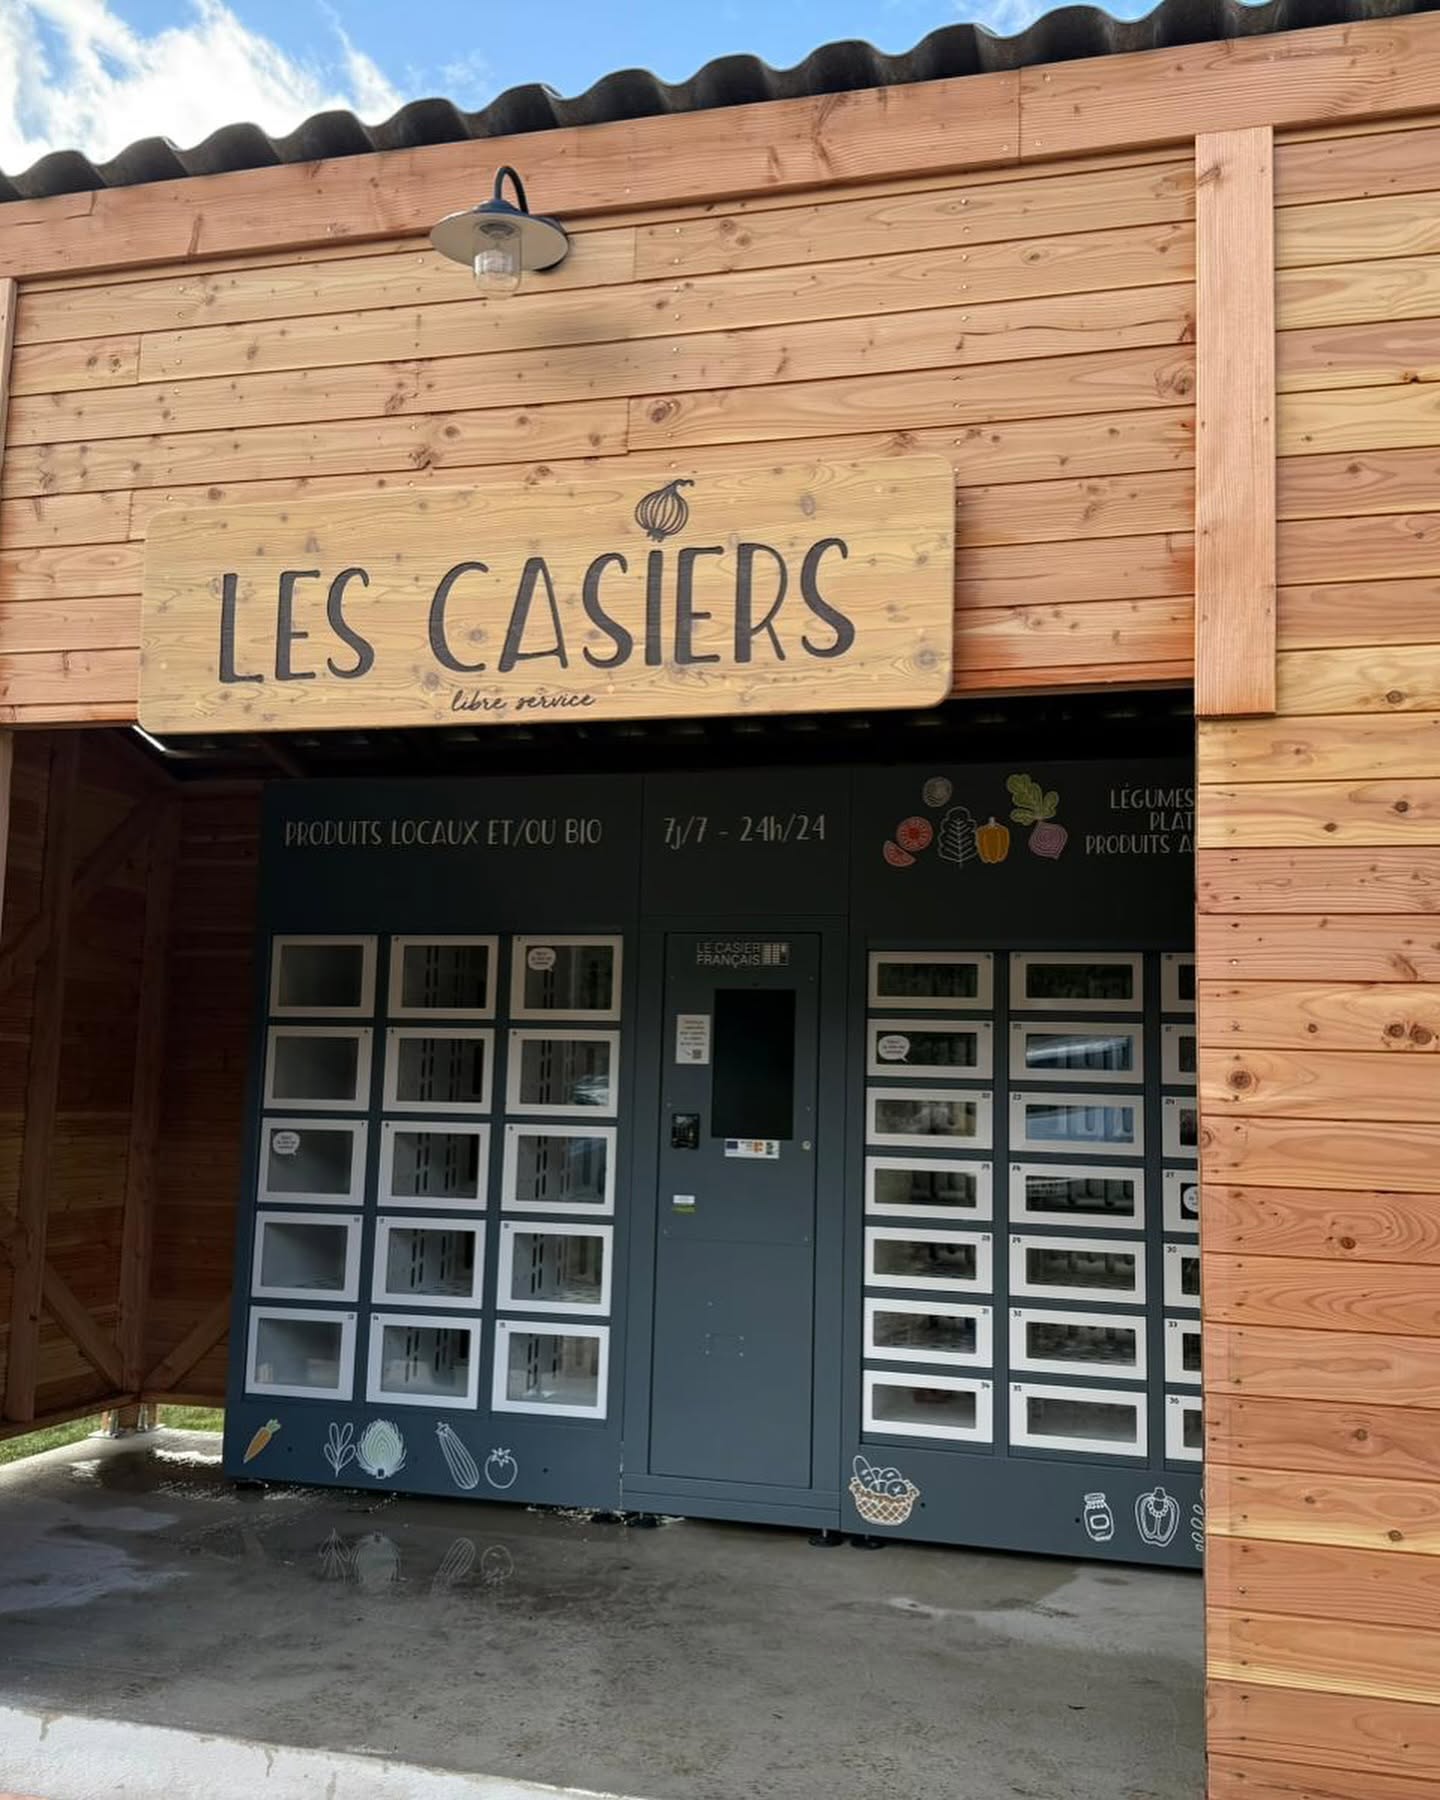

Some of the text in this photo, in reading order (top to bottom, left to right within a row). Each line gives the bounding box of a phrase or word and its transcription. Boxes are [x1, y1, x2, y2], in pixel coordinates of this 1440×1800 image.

[218, 537, 856, 685] LES CASIERS
[451, 689, 597, 713] libre service
[1110, 782, 1194, 809] LÉGUMES
[285, 817, 603, 847] PRODUITS LOCAUX ET/OU BIO
[739, 813, 825, 843] 24h/24
[1085, 833, 1170, 855] PRODUITS
[696, 942, 760, 954] LE CASIER
[696, 954, 760, 969] FRANÇAIS
